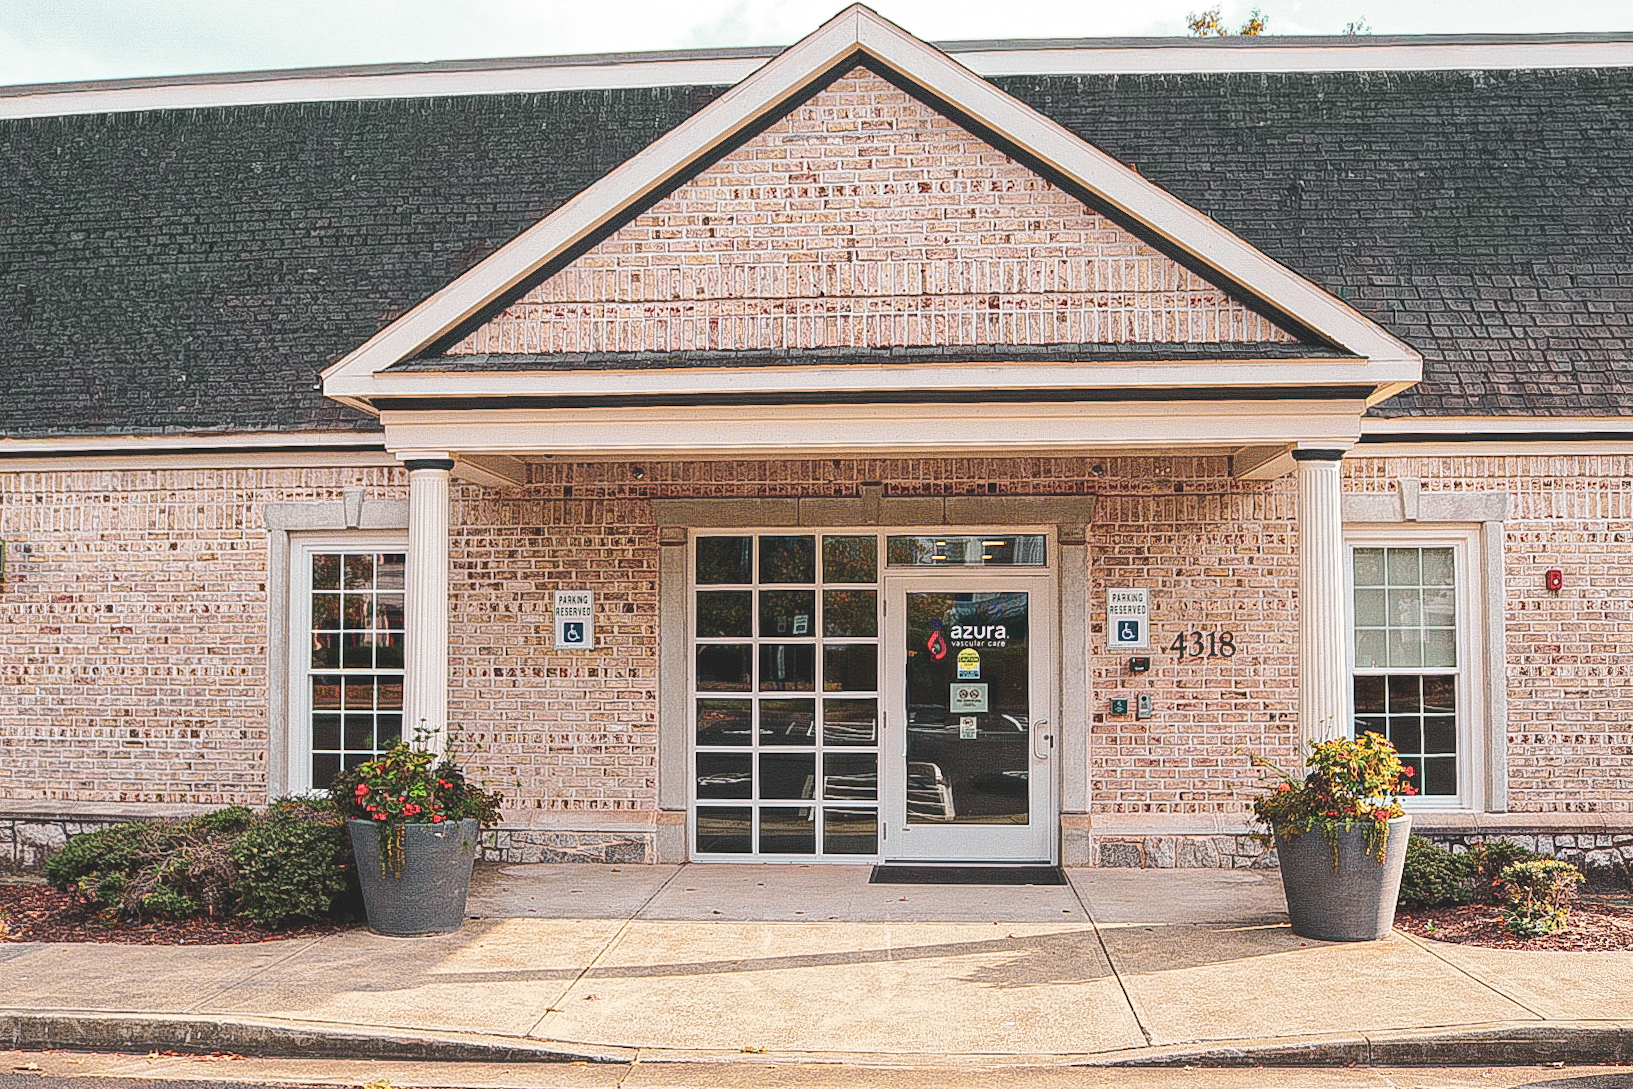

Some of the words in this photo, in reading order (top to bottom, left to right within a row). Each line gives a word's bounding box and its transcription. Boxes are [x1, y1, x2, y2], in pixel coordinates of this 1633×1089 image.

[558, 595, 588, 604] PARKING
[1112, 593, 1144, 602] PARKING
[555, 607, 591, 617] RESERVED
[1109, 605, 1146, 615] RESERVED
[1169, 630, 1237, 660] 4318
